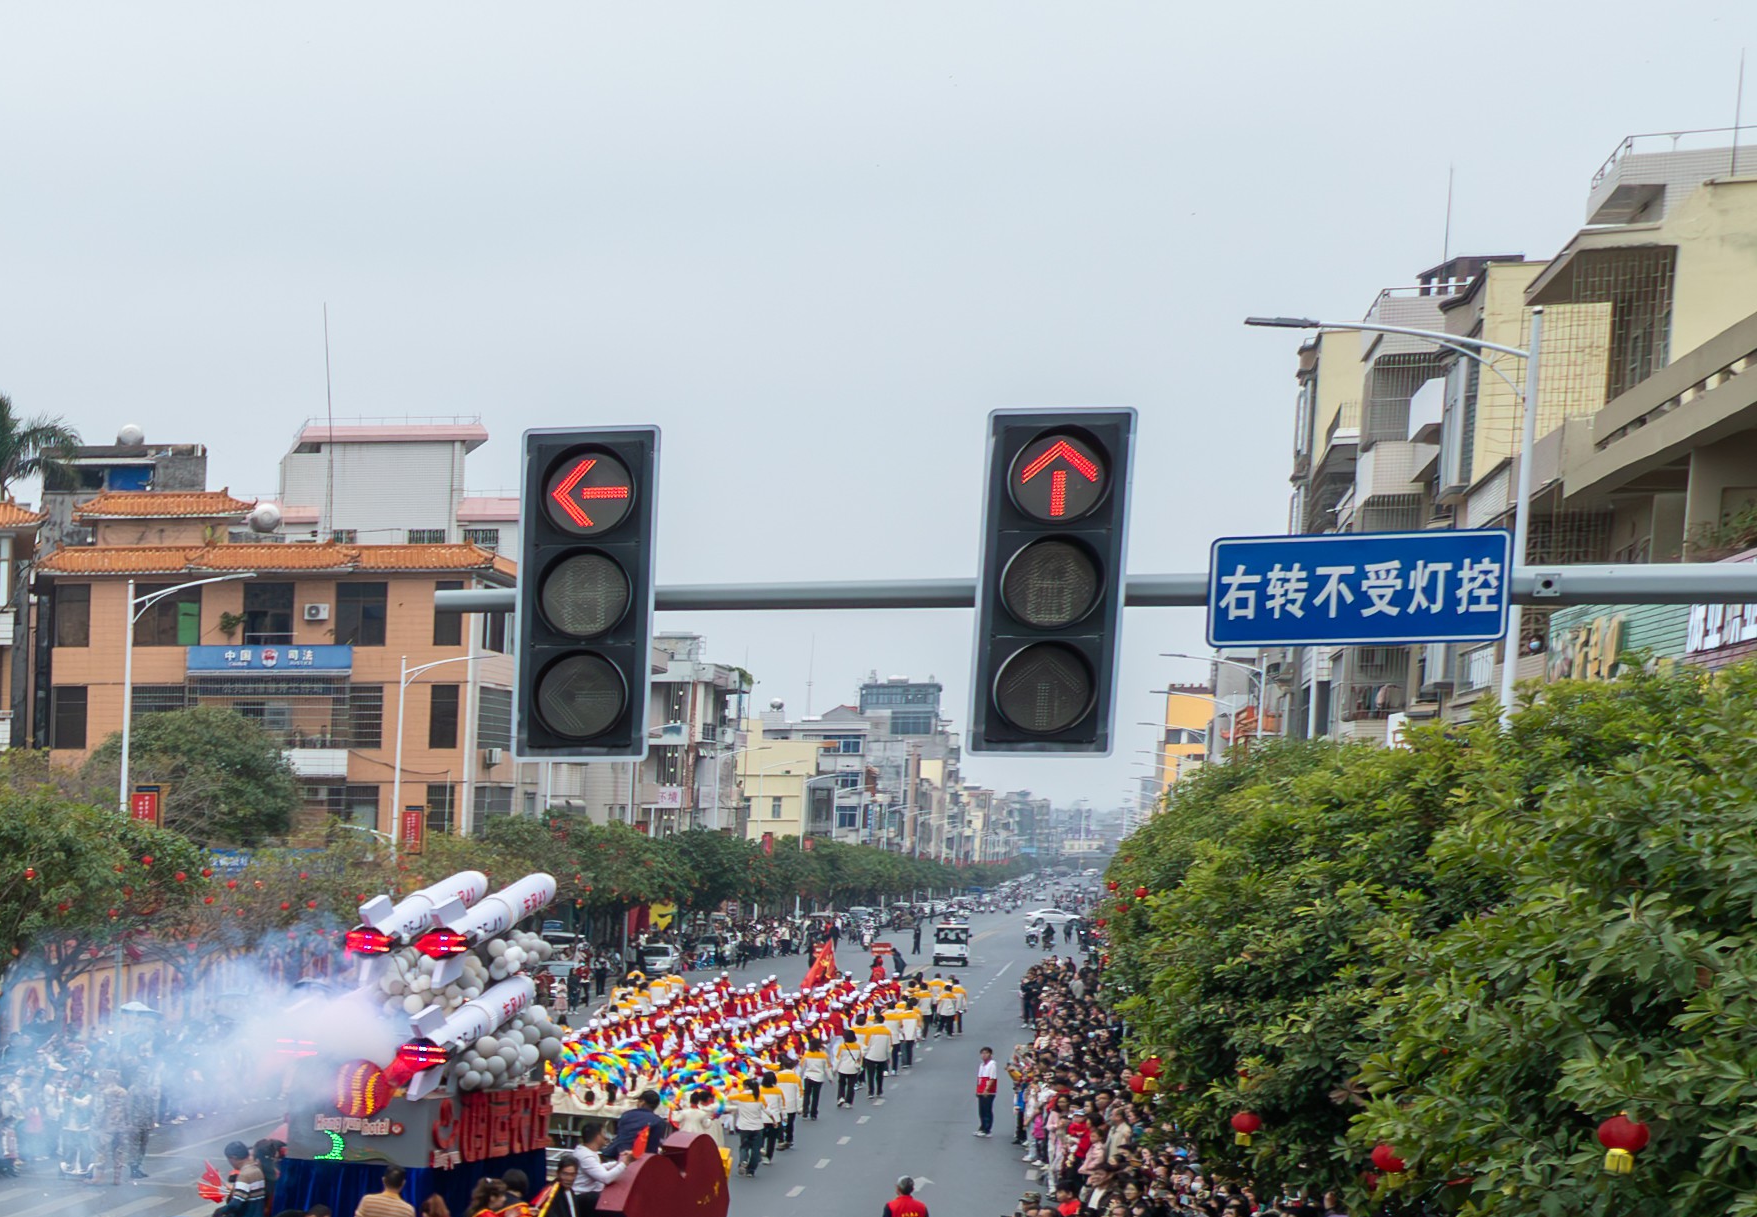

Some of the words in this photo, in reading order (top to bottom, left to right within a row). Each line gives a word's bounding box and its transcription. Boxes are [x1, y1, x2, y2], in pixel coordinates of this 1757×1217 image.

[1219, 558, 1501, 620] 右转不受灯控
[361, 1118, 389, 1136] hotel
